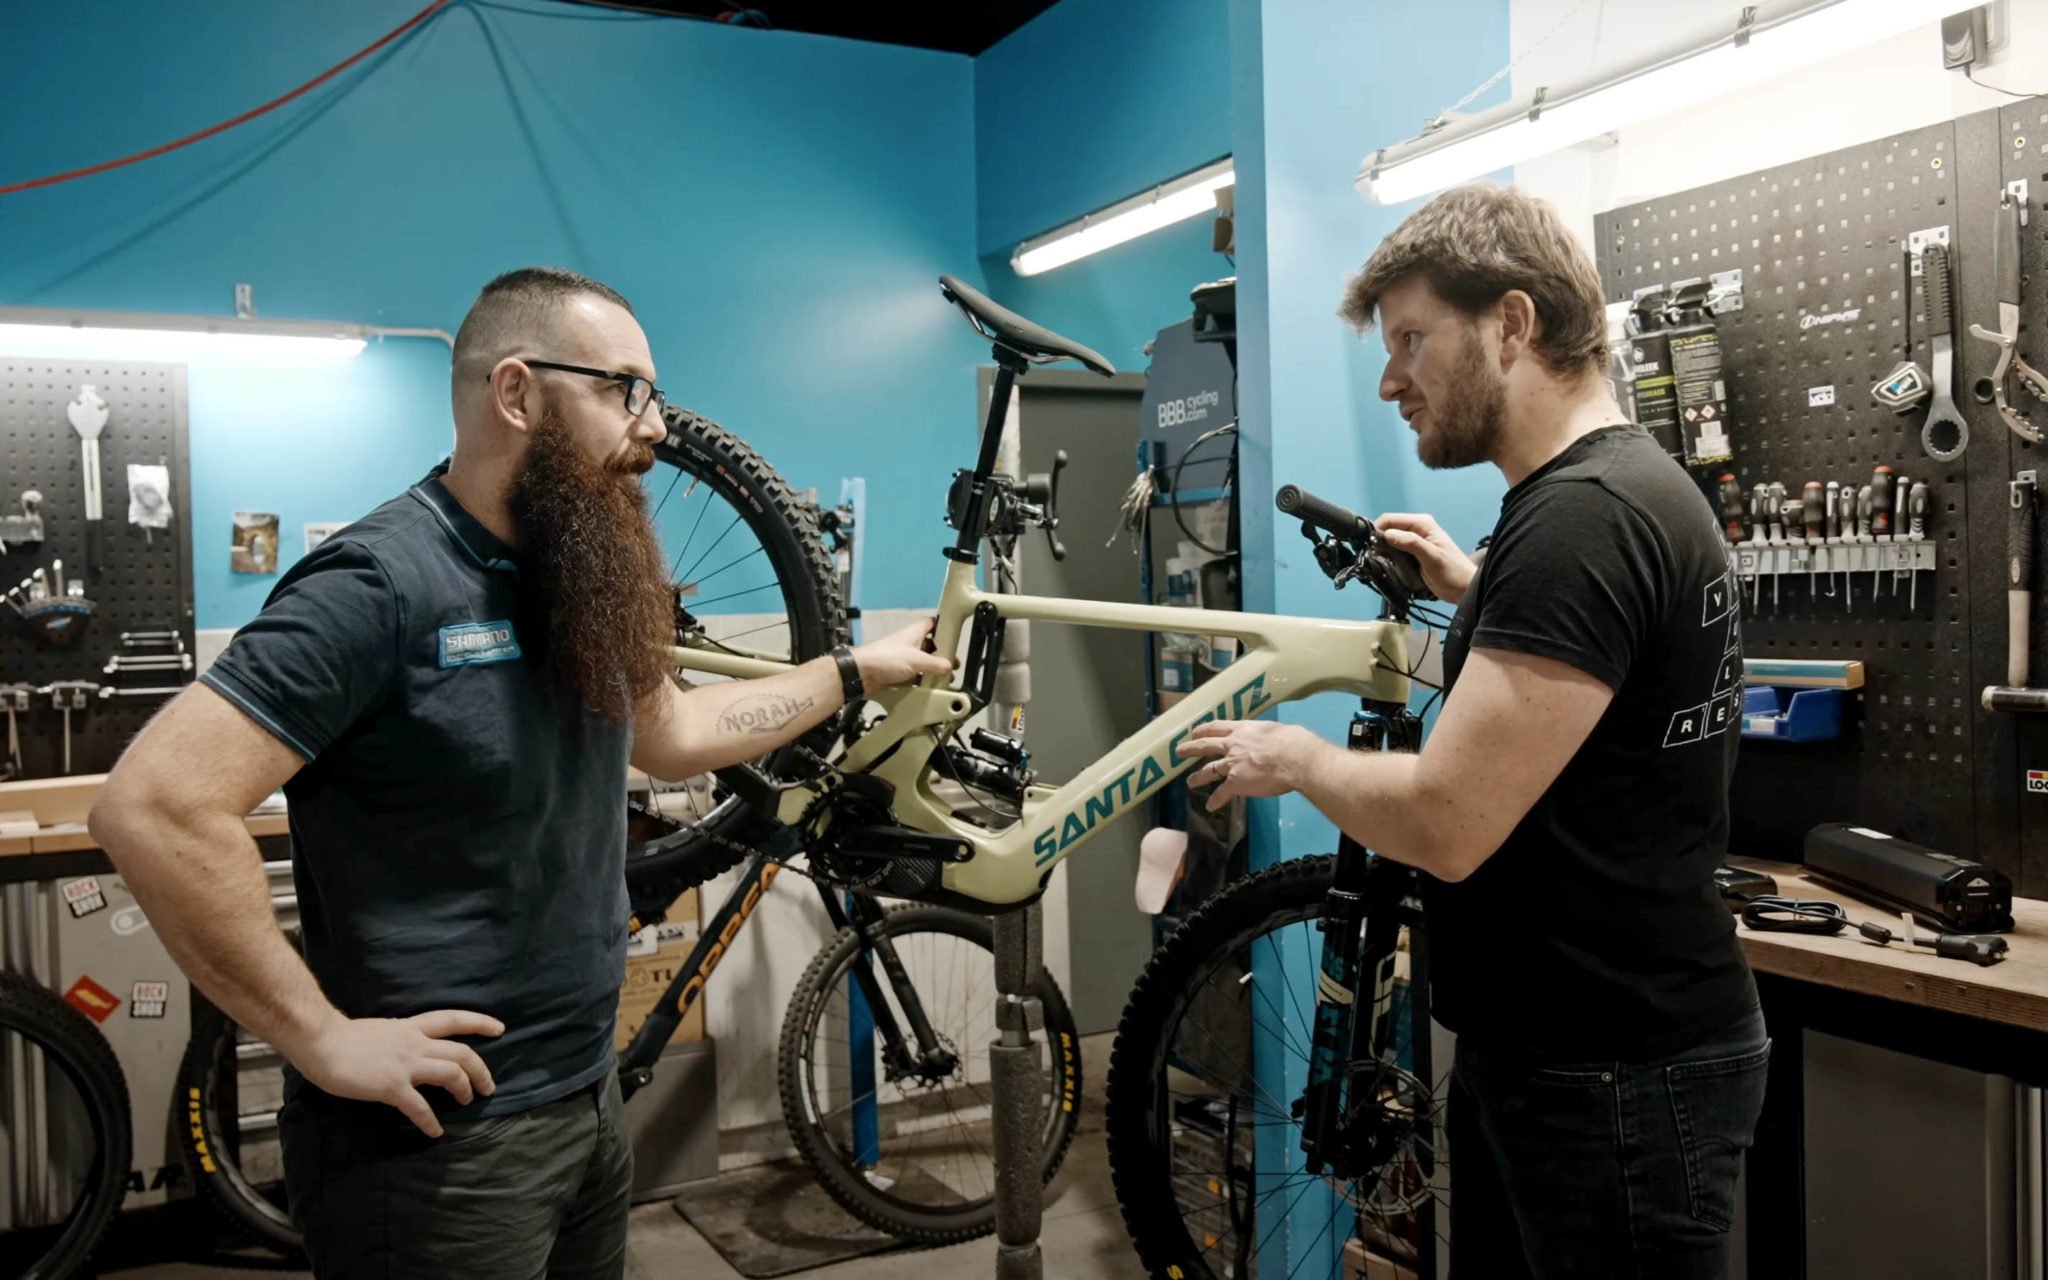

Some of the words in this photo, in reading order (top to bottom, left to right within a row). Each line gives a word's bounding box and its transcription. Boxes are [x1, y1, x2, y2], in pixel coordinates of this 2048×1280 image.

[1158, 399, 1185, 428] BBB
[1186, 390, 1218, 410] cycling
[446, 629, 510, 648] SHIMANO
[724, 699, 800, 732] NORAH
[1034, 755, 1165, 868] SANTA
[678, 863, 780, 1014] ORBEA
[137, 985, 164, 998] ROCK
[1060, 1032, 1074, 1112] MAXXIS
[188, 1087, 216, 1173] MAXXIS
